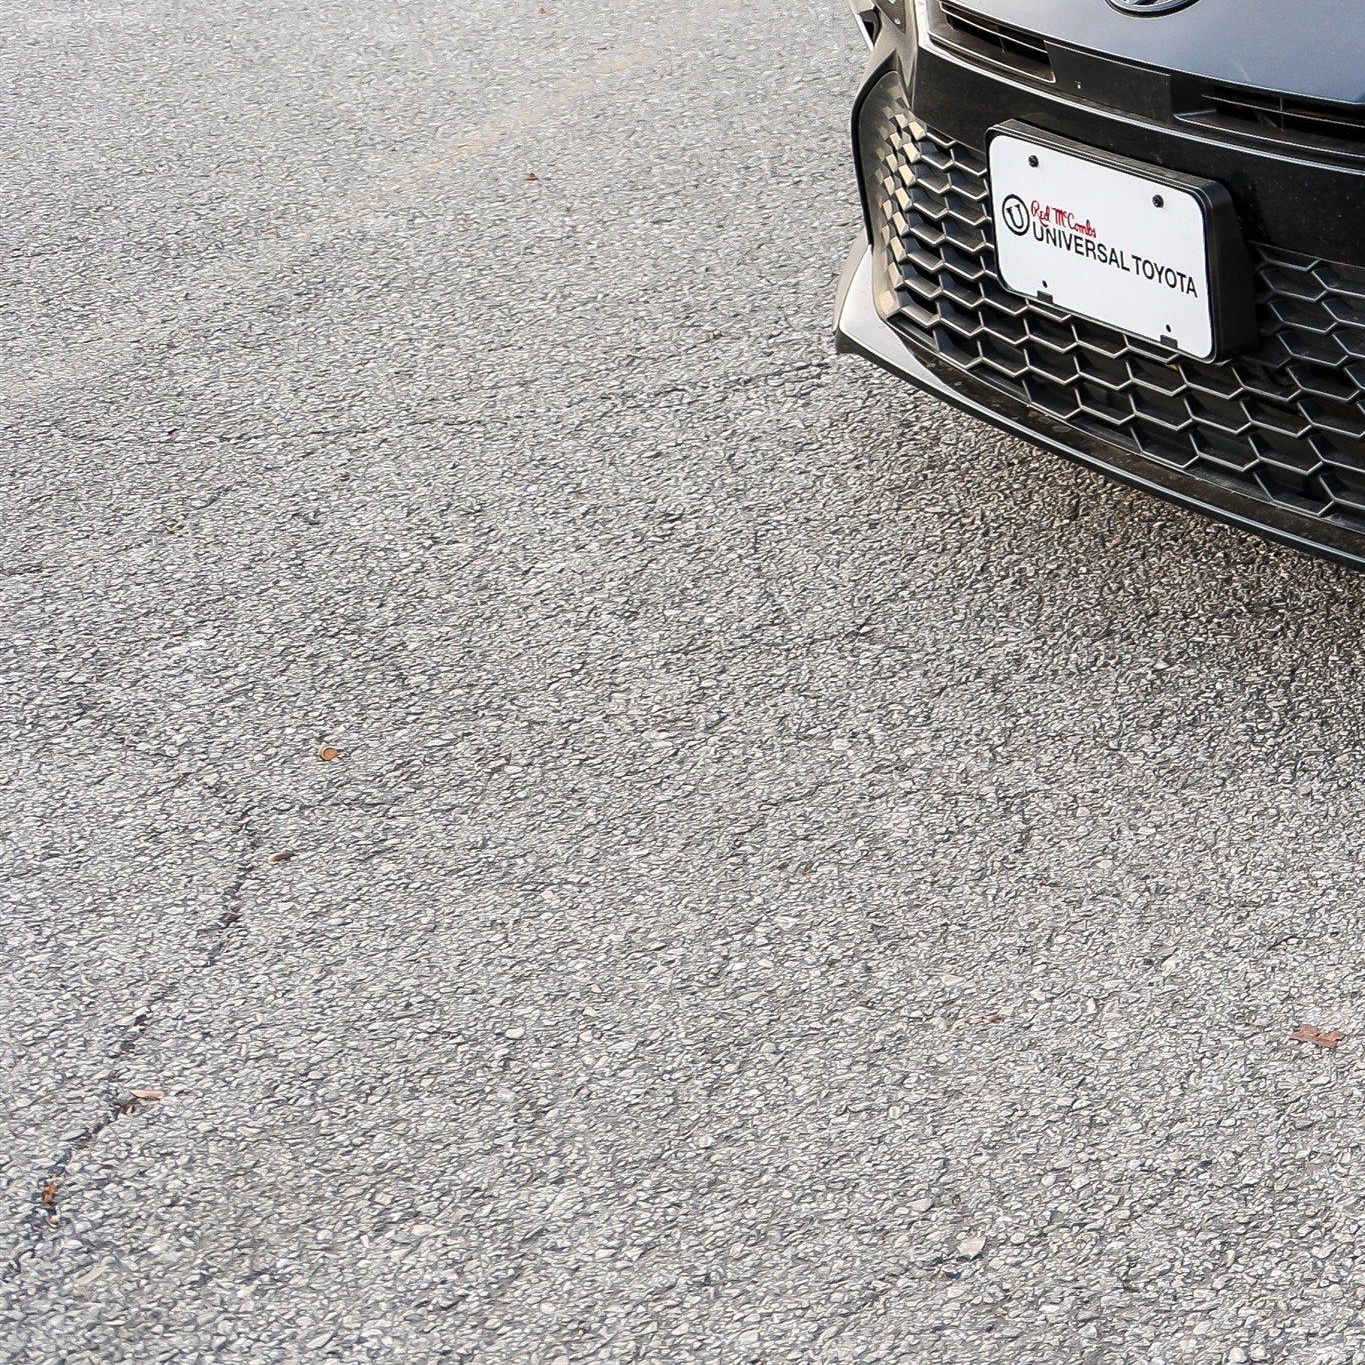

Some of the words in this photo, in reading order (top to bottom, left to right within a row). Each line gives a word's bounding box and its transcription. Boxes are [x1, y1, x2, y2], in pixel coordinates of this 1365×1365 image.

[1030, 200, 1051, 228] Red
[1051, 206, 1097, 238] McCombs
[1032, 221, 1131, 272] UNIVERSAL
[1131, 254, 1198, 298] TOYOTA
